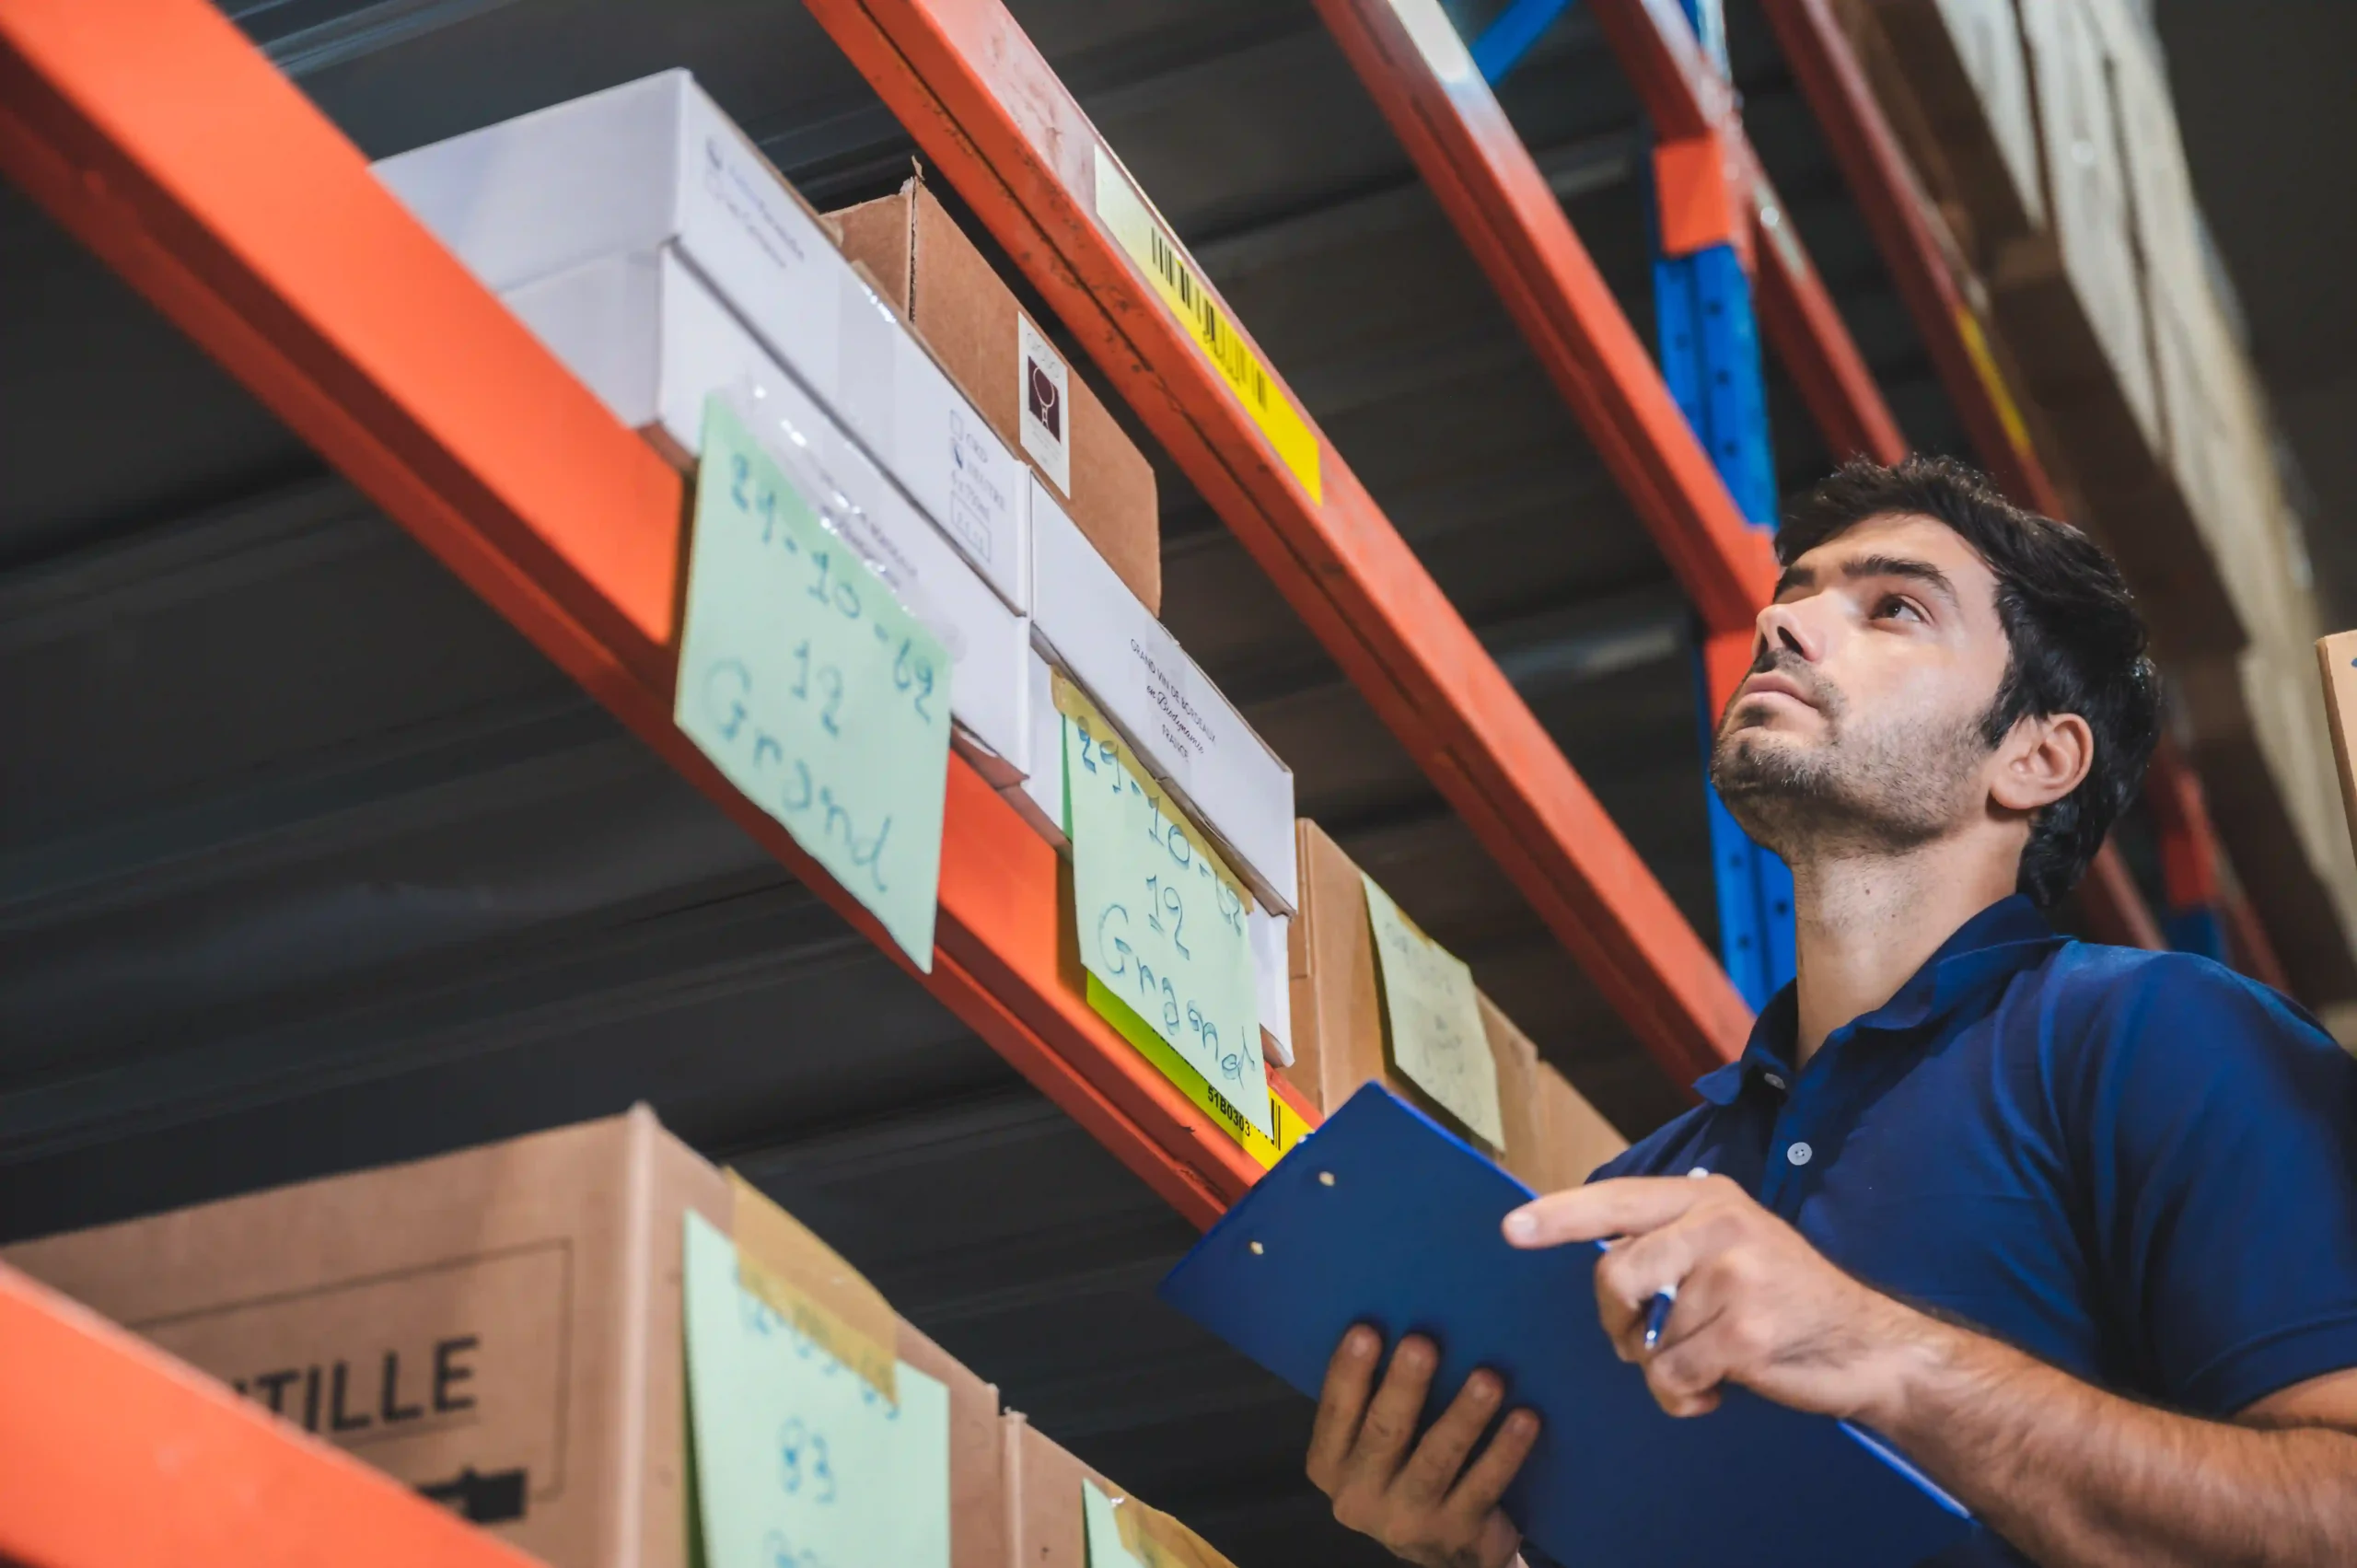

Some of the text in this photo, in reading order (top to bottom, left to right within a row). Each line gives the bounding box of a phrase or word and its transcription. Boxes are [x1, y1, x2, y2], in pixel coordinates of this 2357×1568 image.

[789, 640, 843, 739] 12
[1131, 638, 1215, 744] GRAND VIN DE BORDEAUX
[1157, 691, 1204, 754] Biodynamie
[702, 657, 893, 893] Grand
[1146, 875, 1190, 961] 12
[1207, 1085, 1250, 1137] 51B0303
[234, 1335, 480, 1434] TILLE
